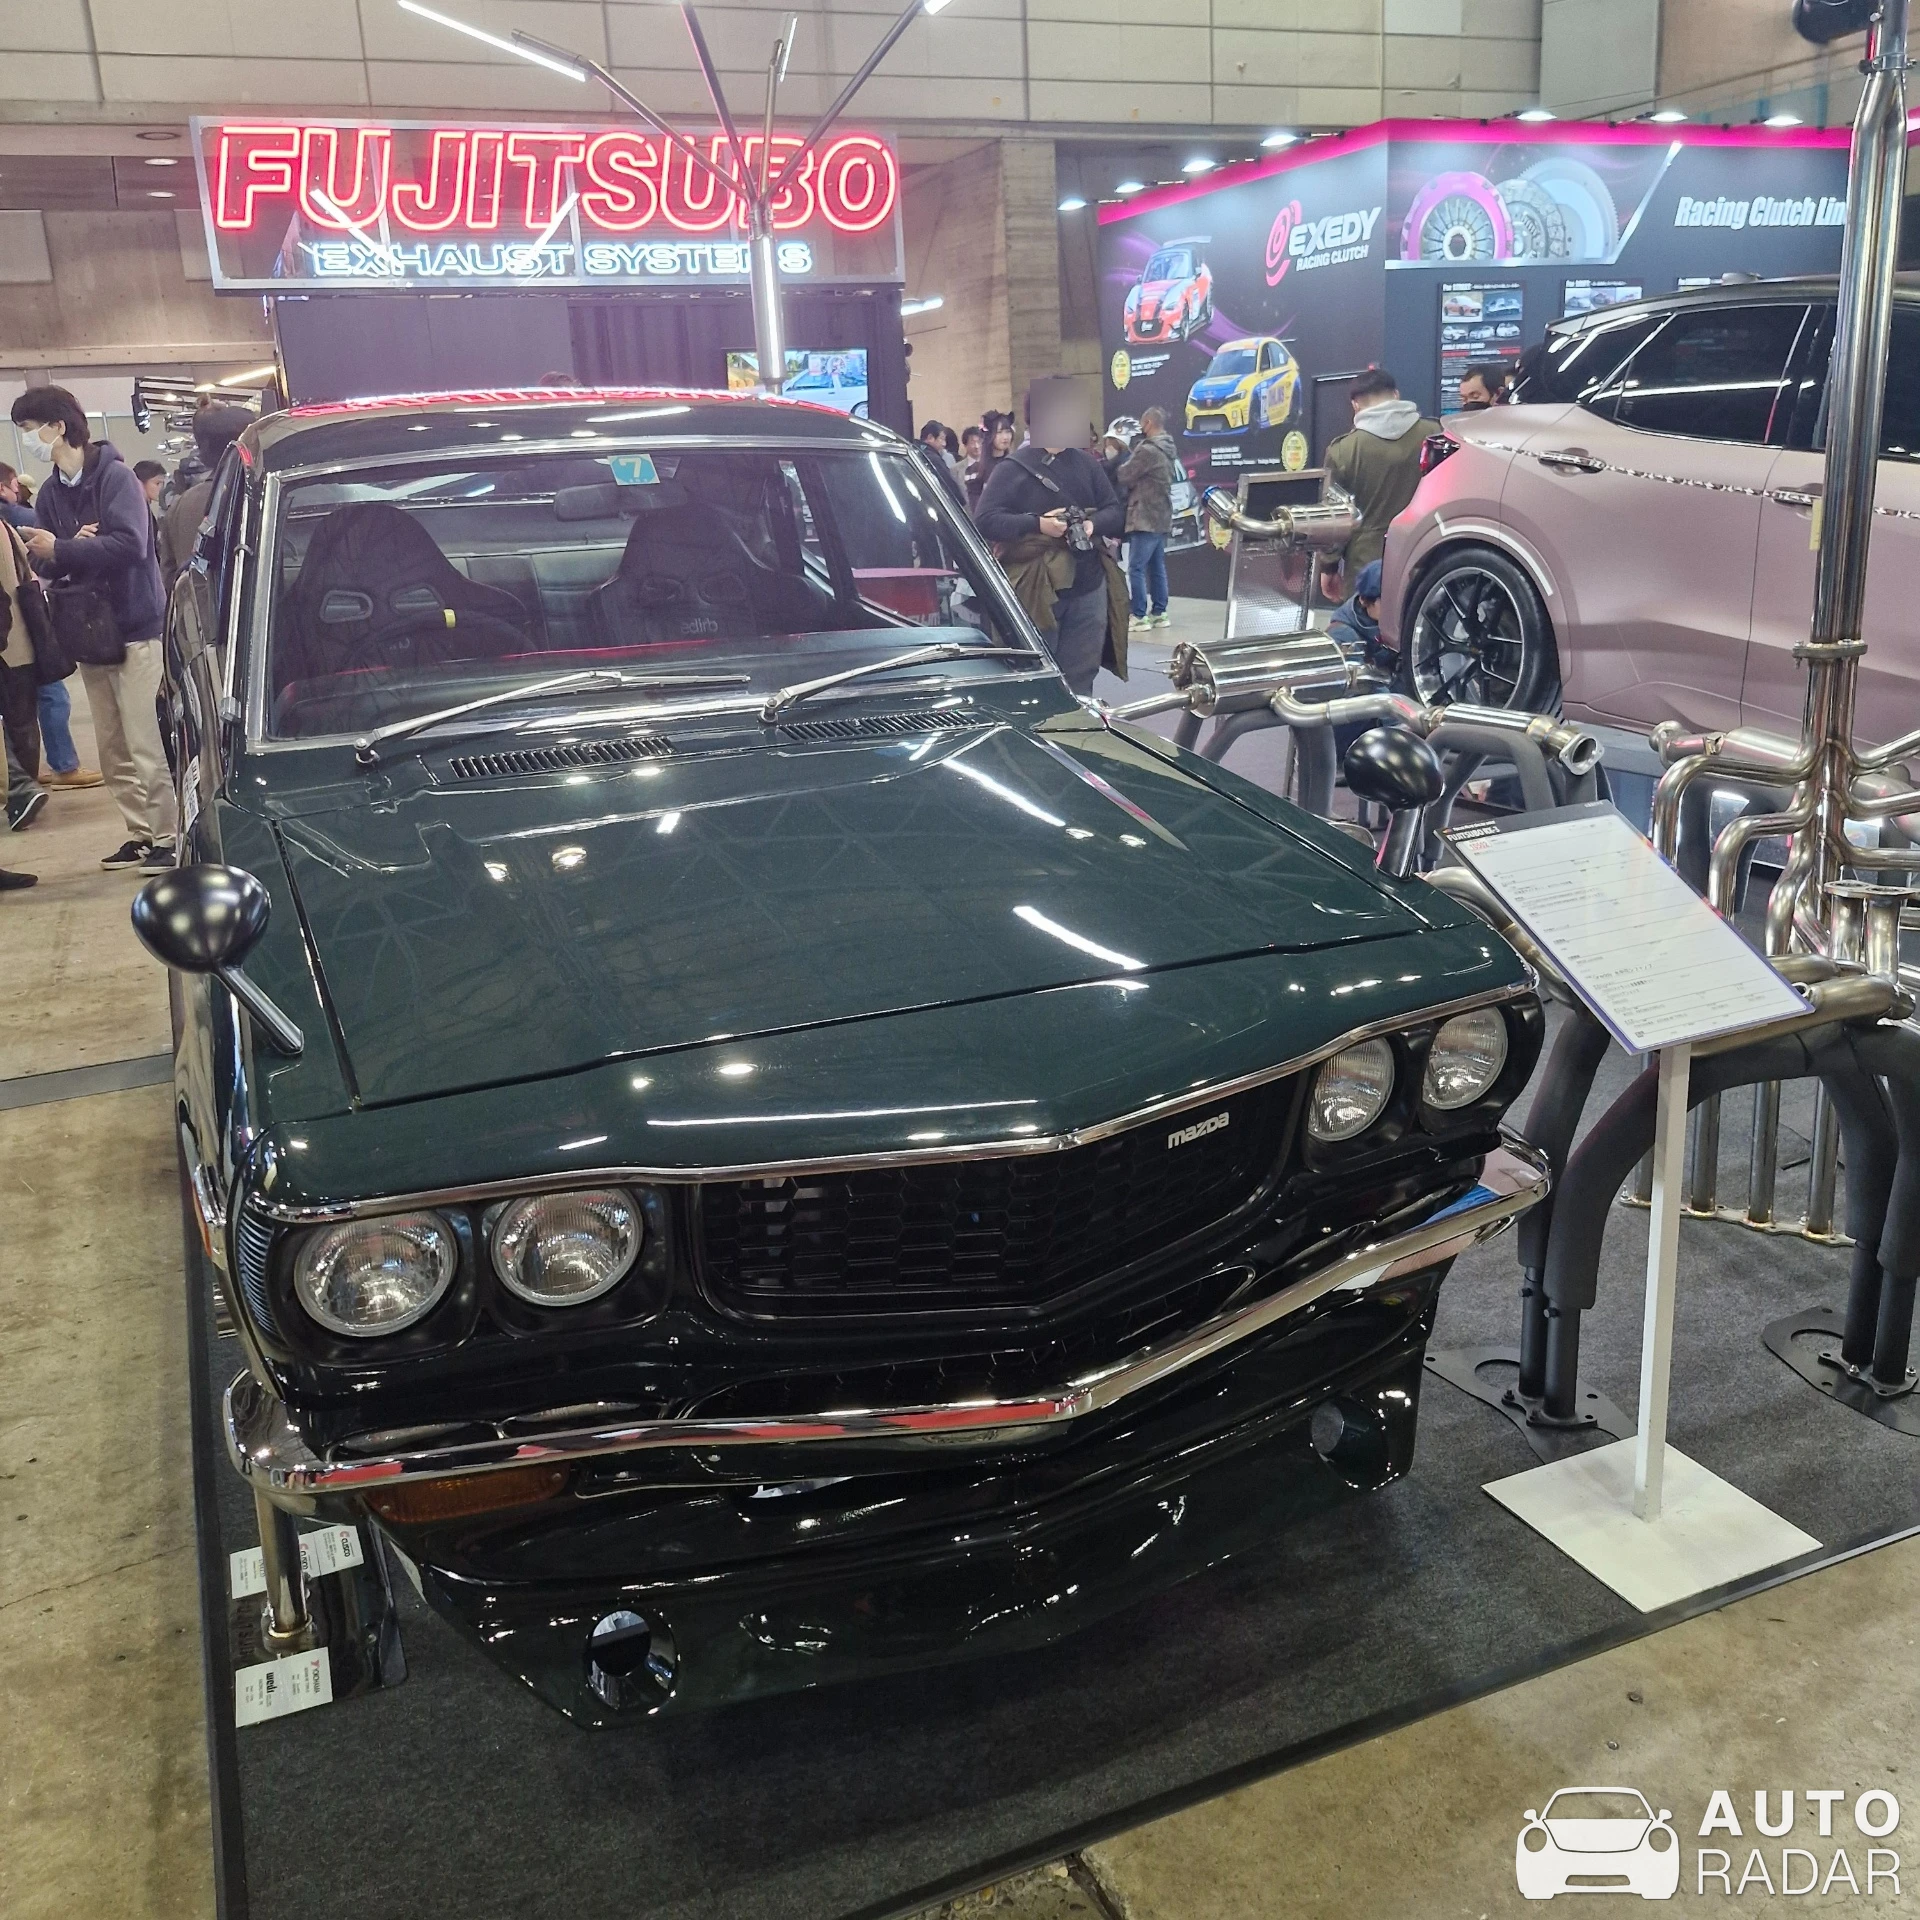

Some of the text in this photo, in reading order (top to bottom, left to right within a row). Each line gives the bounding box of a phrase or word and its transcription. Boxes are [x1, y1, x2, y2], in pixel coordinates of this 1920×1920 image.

[217, 126, 896, 231] FUJITSUBO
[1674, 196, 1846, 230] Racing Clutch Lin
[1288, 206, 1382, 257] EXEDY
[313, 243, 813, 276] EXHAUST SYSTES
[1296, 244, 1370, 272] RACING CLUTCH
[618, 457, 642, 478] 7
[1167, 1111, 1230, 1150] mazda
